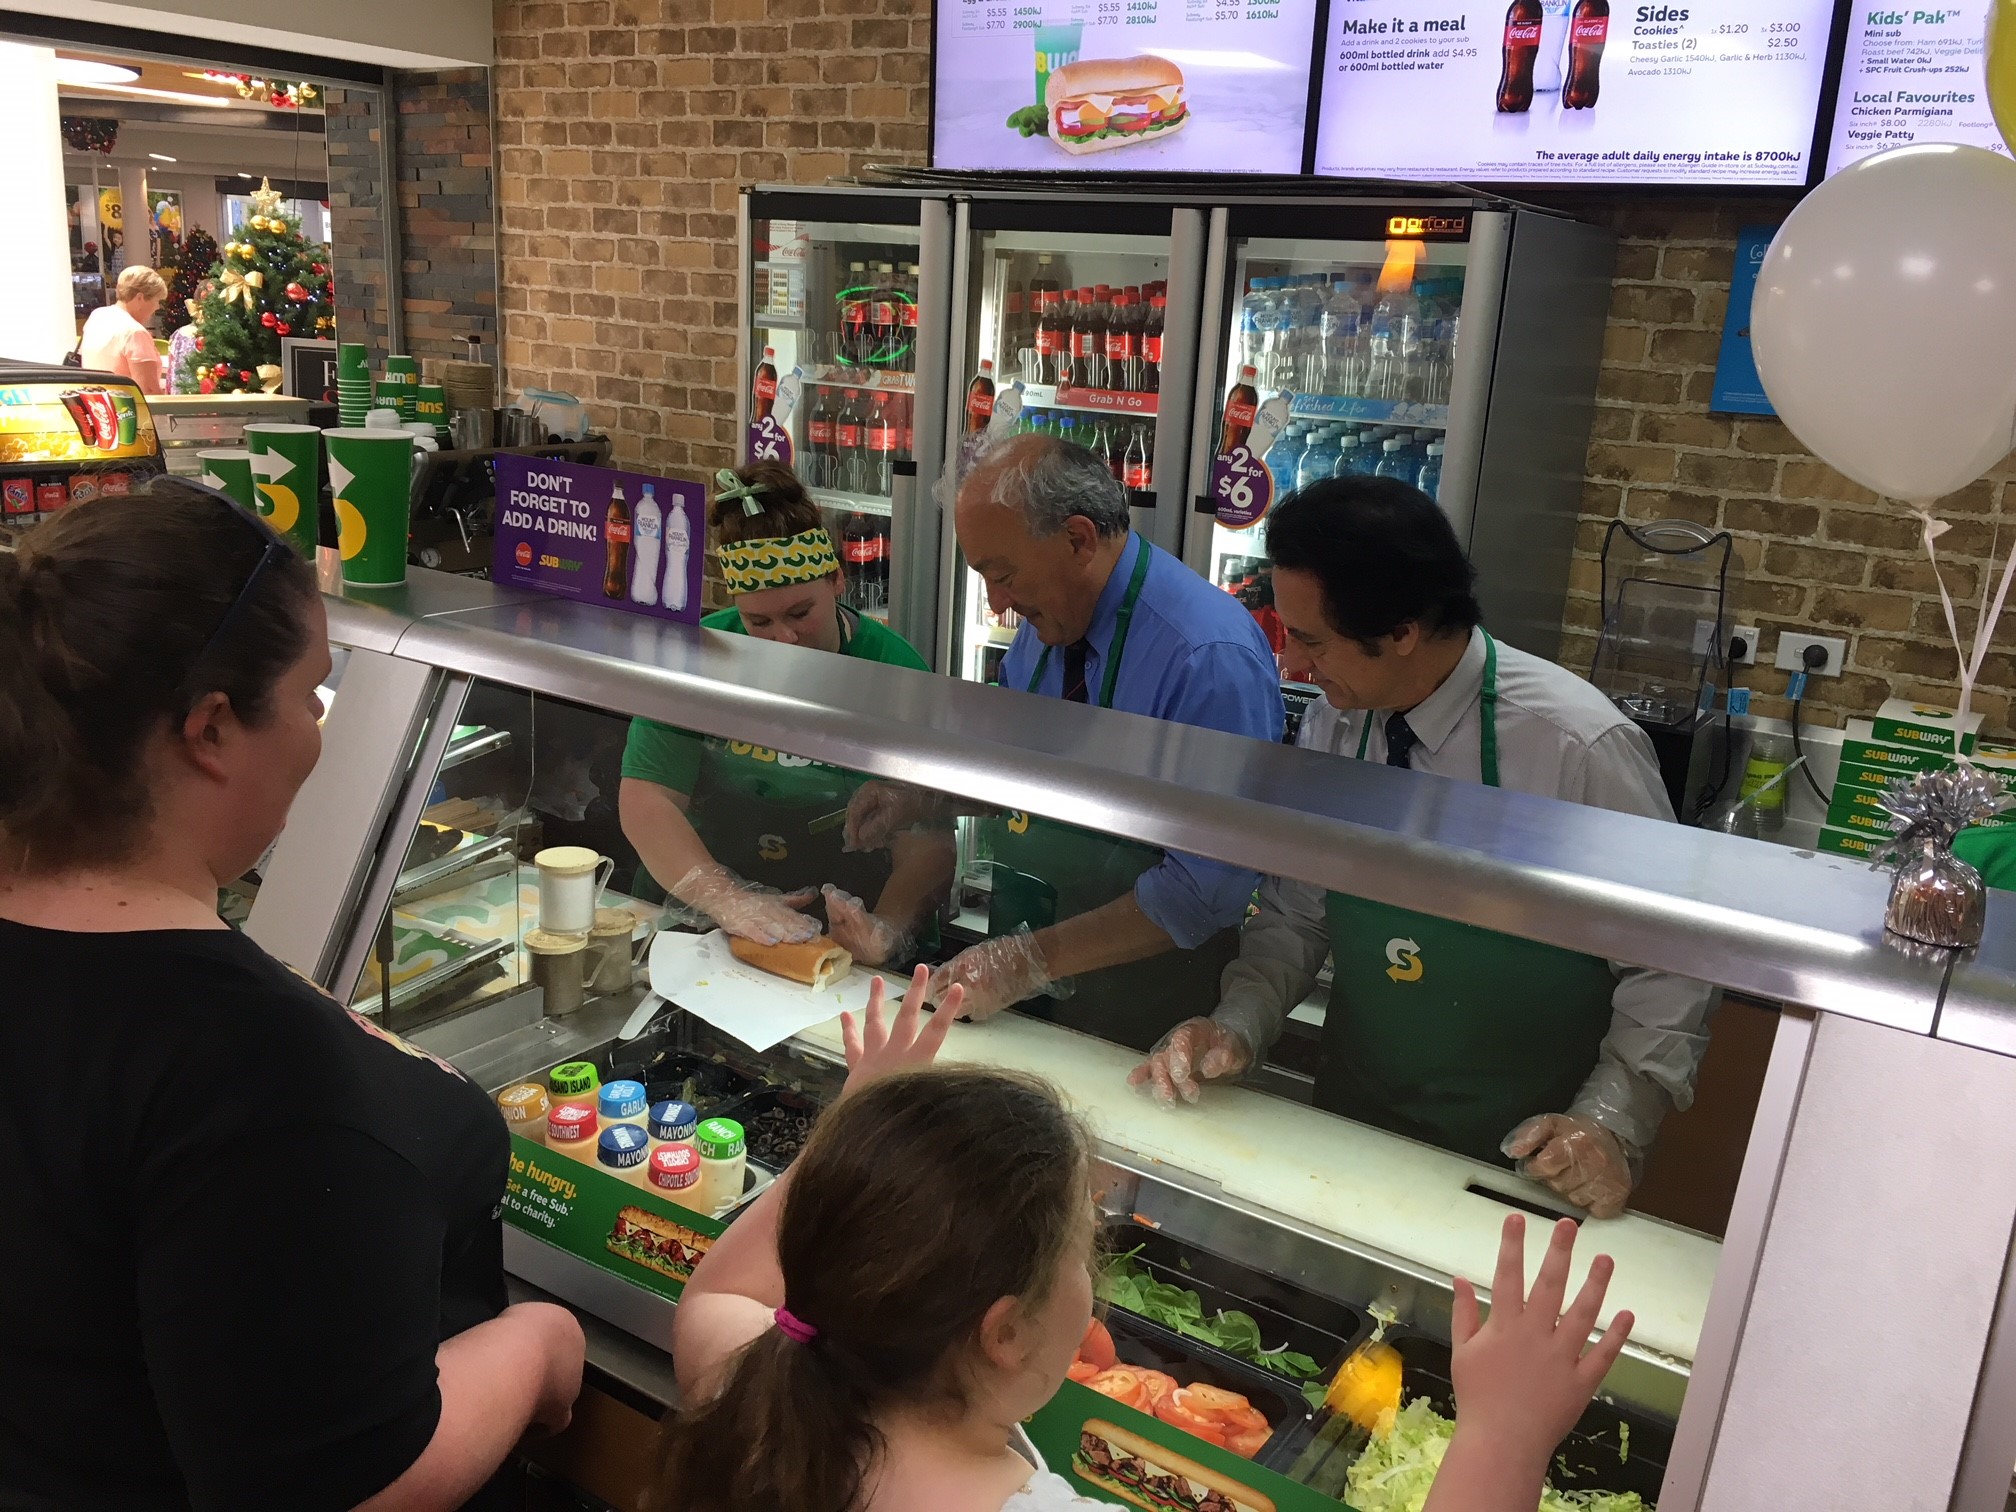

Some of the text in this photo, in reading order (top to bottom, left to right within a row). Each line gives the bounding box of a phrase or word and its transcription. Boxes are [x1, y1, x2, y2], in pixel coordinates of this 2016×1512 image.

[987, 7, 1042, 17] $5.55 1450kJ
[1099, 1, 1157, 12] $5.55 1410kJ
[1098, 15, 1157, 25] $7.70 2810kJ
[1215, 11, 1238, 20] $5.70
[1246, 10, 1279, 19] 1610kJ
[1636, 5, 1689, 22] Sides
[986, 20, 1042, 29] $7.70 2900kJ
[1343, 15, 1466, 34] Make it a meal
[1719, 24, 1748, 34] $1.20
[1769, 22, 1801, 33] $3.00
[1864, 30, 1883, 38] Mini
[1438, 37, 1455, 45] your
[1632, 37, 1798, 50] Toasties (2) $2.50
[1340, 48, 1477, 60] 600ml bottled drink add $4.95
[1630, 56, 1658, 64] Cheesy
[1660, 55, 1683, 63] Garlic
[1720, 53, 1743, 61] Garlic
[1752, 53, 1773, 61] Herb
[1934, 48, 1962, 57] Veggie
[1350, 62, 1379, 71] 600ml
[1381, 61, 1415, 71] bottled
[1417, 61, 1444, 70] water
[1628, 68, 1692, 76] Avocado 1310kJ
[1904, 66, 1943, 74] Crush-ups
[1854, 91, 1975, 103] Local Favourites
[1851, 107, 1953, 117] Chicken Parmigiana
[1881, 119, 1906, 127] $8.00
[1917, 119, 1952, 127] 2280kJ
[1848, 130, 1914, 141] Veggie Patty
[1536, 150, 1801, 163] The average adult daily energy intake is 8700kJ
[1089, 394, 1142, 407] Grab N Go
[117, 411, 134, 420] Sprite
[751, 416, 785, 442] any 2 for
[1217, 447, 1263, 477] any 2 for
[527, 471, 572, 493] DON'T
[1218, 475, 1254, 508] $6
[510, 490, 590, 518] FORGET TO
[502, 510, 597, 541] ADD A DRINK!
[1894, 727, 1951, 744] SUBWAY
[1862, 750, 1919, 765] SUBWAY
[571, 1076, 591, 1092] ISLAND
[551, 1125, 579, 1139] SOUTHWEST
[705, 1121, 736, 1139] RANCH
[526, 1160, 577, 1200] hungry.
[659, 1172, 683, 1187] CHIPOTLE
[522, 1188, 529, 1197] a
[529, 1189, 548, 1206] free
[511, 1198, 520, 1211] to
